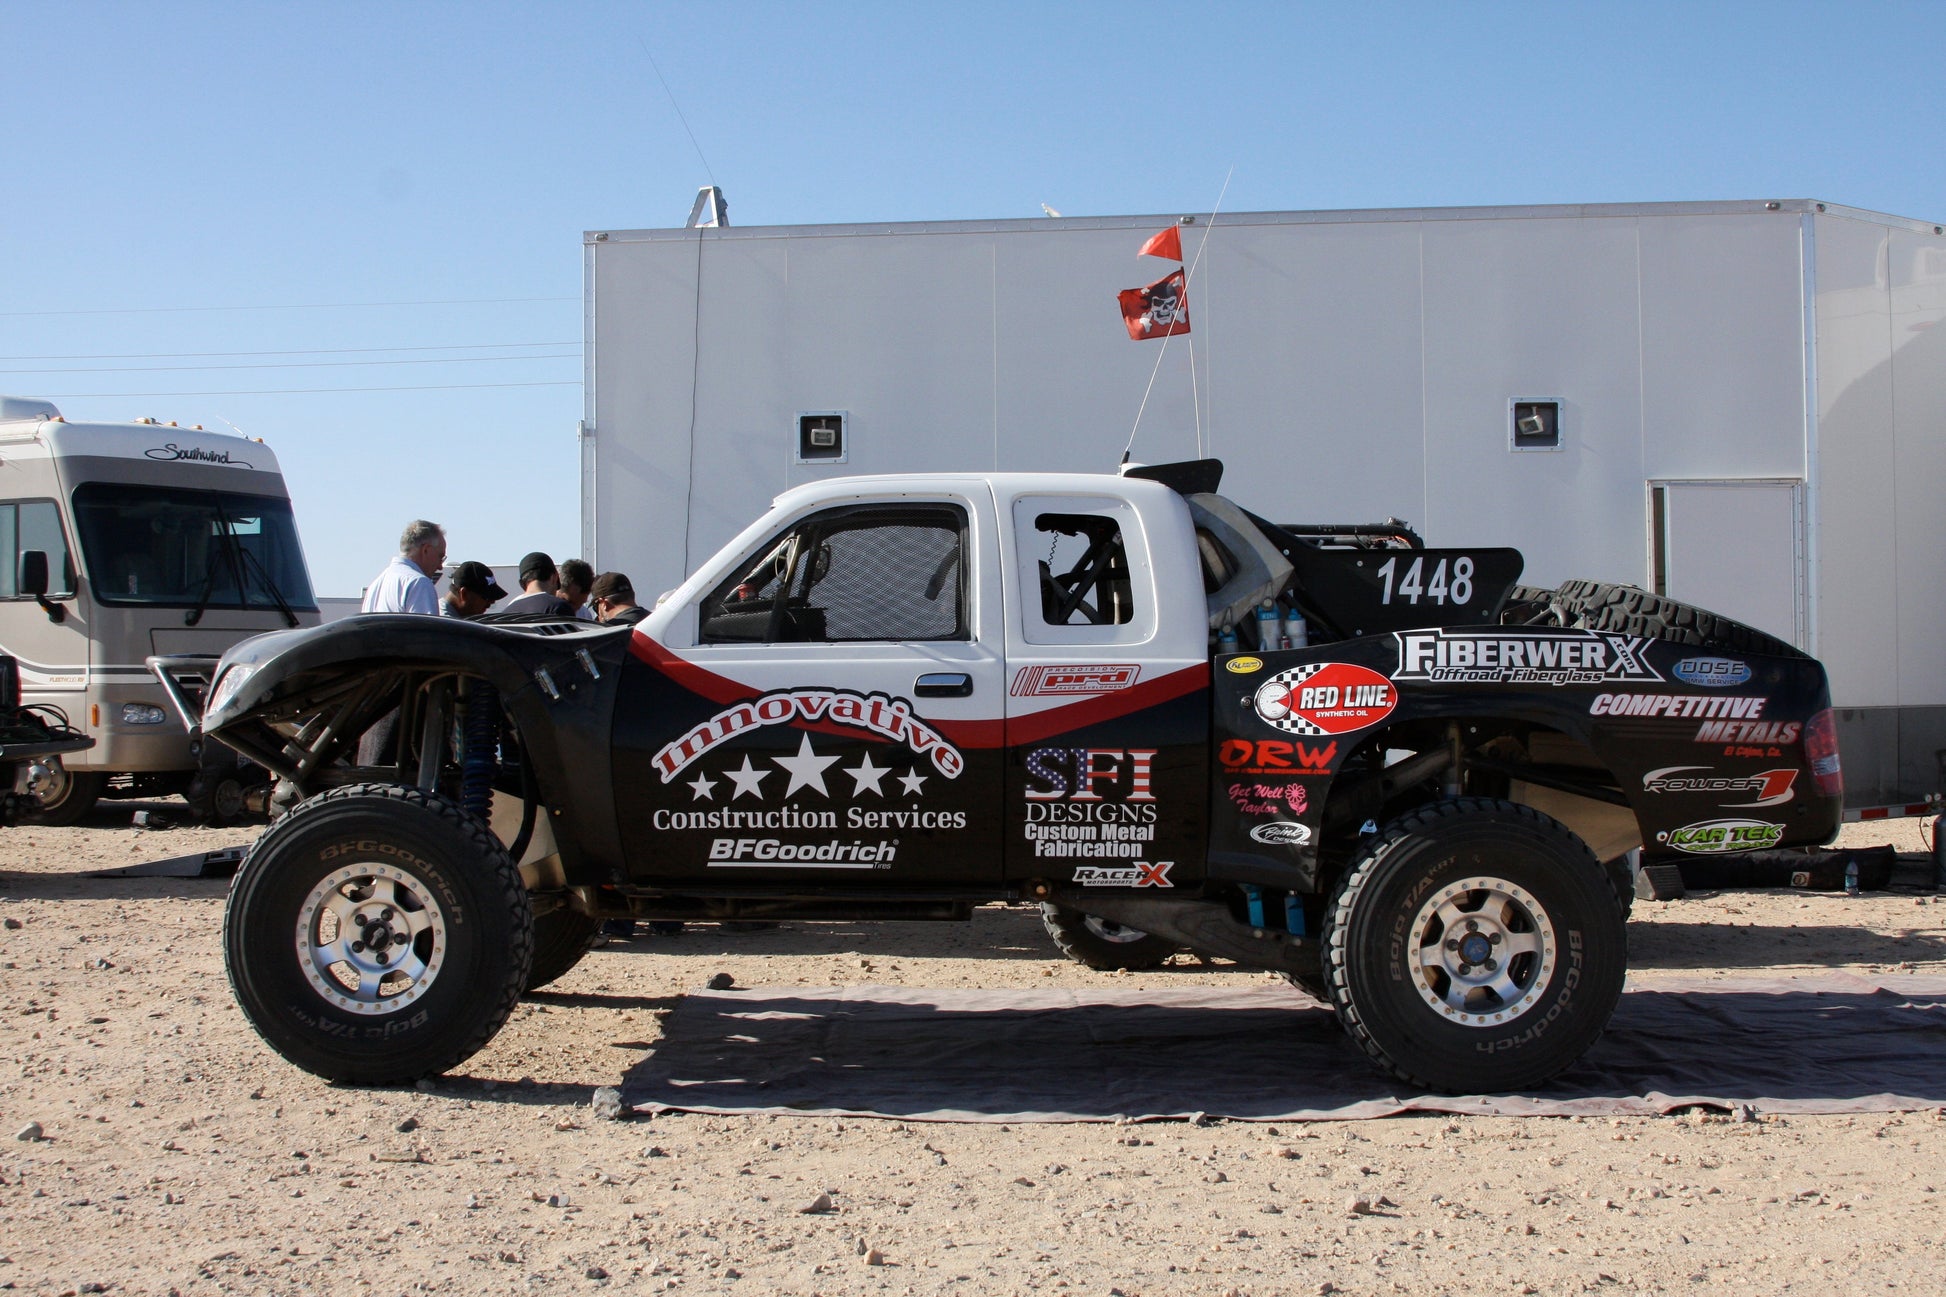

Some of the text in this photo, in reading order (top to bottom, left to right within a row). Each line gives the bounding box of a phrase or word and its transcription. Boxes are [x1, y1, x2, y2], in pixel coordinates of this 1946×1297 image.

[144, 443, 253, 469] Southwind
[1377, 556, 1474, 606] 1448
[1431, 667, 1604, 686] Offroad Fiberglass
[1681, 660, 1745, 675] DOSE
[1300, 686, 1339, 710] RED
[1589, 693, 1768, 719] COMPETITIVE
[1315, 710, 1355, 718] SYNTHETIC
[652, 690, 964, 783] Innovative
[1694, 720, 1801, 744] METALS
[1218, 739, 1337, 768] ORW
[1024, 748, 1158, 801] SFI
[1228, 783, 1284, 800] Get Well
[652, 803, 967, 831] Construction Services
[1024, 802, 1158, 823] DESIGNS
[1236, 798, 1279, 816] Taylor
[1024, 822, 1155, 841] Custom Metal
[1672, 824, 1784, 845] KAR TEK
[1035, 840, 1143, 858] Fabrication
[319, 839, 464, 925] BFGoodrich
[1475, 929, 1585, 1055] BFGoodrich
